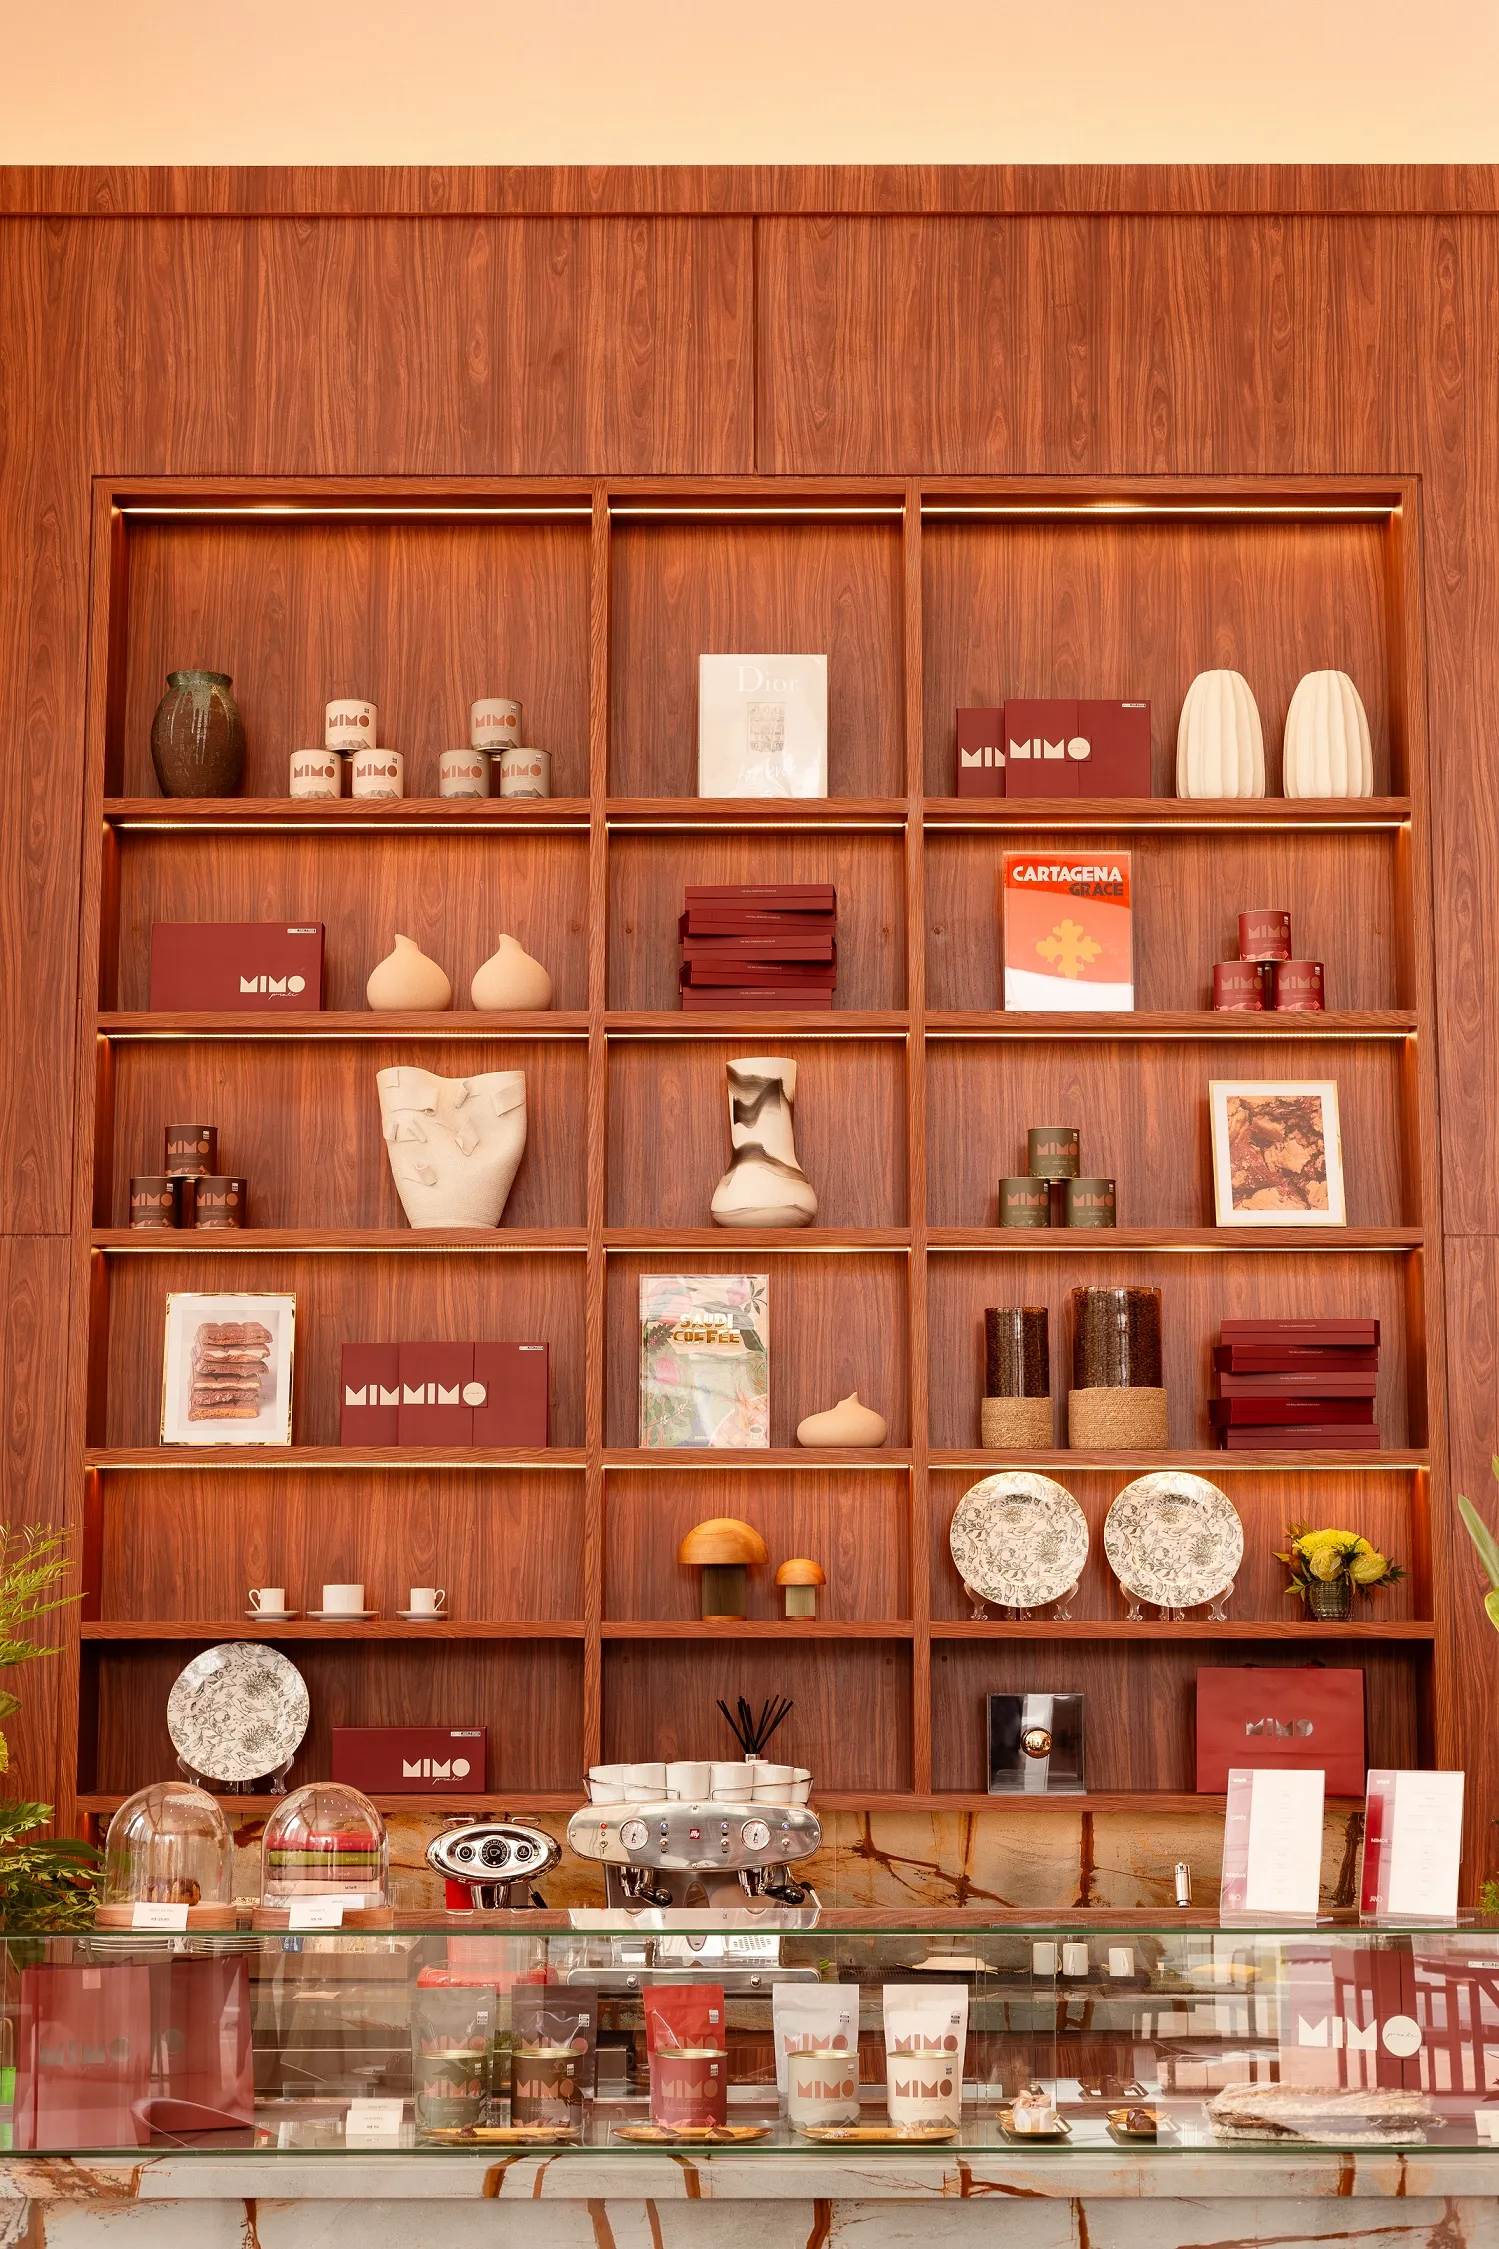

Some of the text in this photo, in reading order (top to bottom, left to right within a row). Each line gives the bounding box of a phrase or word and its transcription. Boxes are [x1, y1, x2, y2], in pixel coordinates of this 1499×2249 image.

[736, 665, 798, 692] Dior
[329, 714, 369, 728] MIMO
[476, 714, 516, 728] MIMO
[1009, 737, 1091, 760] MIMO
[294, 765, 335, 778] MIMO
[357, 764, 397, 777] MIMO
[442, 765, 482, 779] MIMO
[502, 764, 541, 778] MIMO
[1012, 866, 1123, 882] CARTAGENA
[1069, 883, 1124, 896] GRACE
[1248, 925, 1289, 939] MIMO
[240, 975, 306, 992] MIMO
[1222, 977, 1262, 990] MIMO
[1279, 976, 1320, 990] MIMO
[168, 1140, 209, 1154] MIMO
[1036, 1142, 1078, 1155] MIMO
[131, 1193, 173, 1206] MIMO
[197, 1193, 239, 1206] MIMO
[1007, 1193, 1048, 1206] MIMO
[1073, 1193, 1113, 1206] MIMO
[680, 1313, 734, 1329] SAUDI
[672, 1329, 740, 1345] COFFEE
[403, 1382, 487, 1406] MIMO
[1246, 1718, 1313, 1736] MIMO
[402, 1758, 470, 1777] MIMO
[784, 2033, 849, 2052] MIMO
[894, 2034, 959, 2052] MIMO
[1298, 2015, 1422, 2057] MIMO
[424, 2079, 481, 2097] MIMO
[517, 2079, 574, 2097] MIMO
[661, 2080, 718, 2098] MIMO
[797, 2079, 855, 2098] MIMO
[896, 2079, 953, 2098] MIMO
